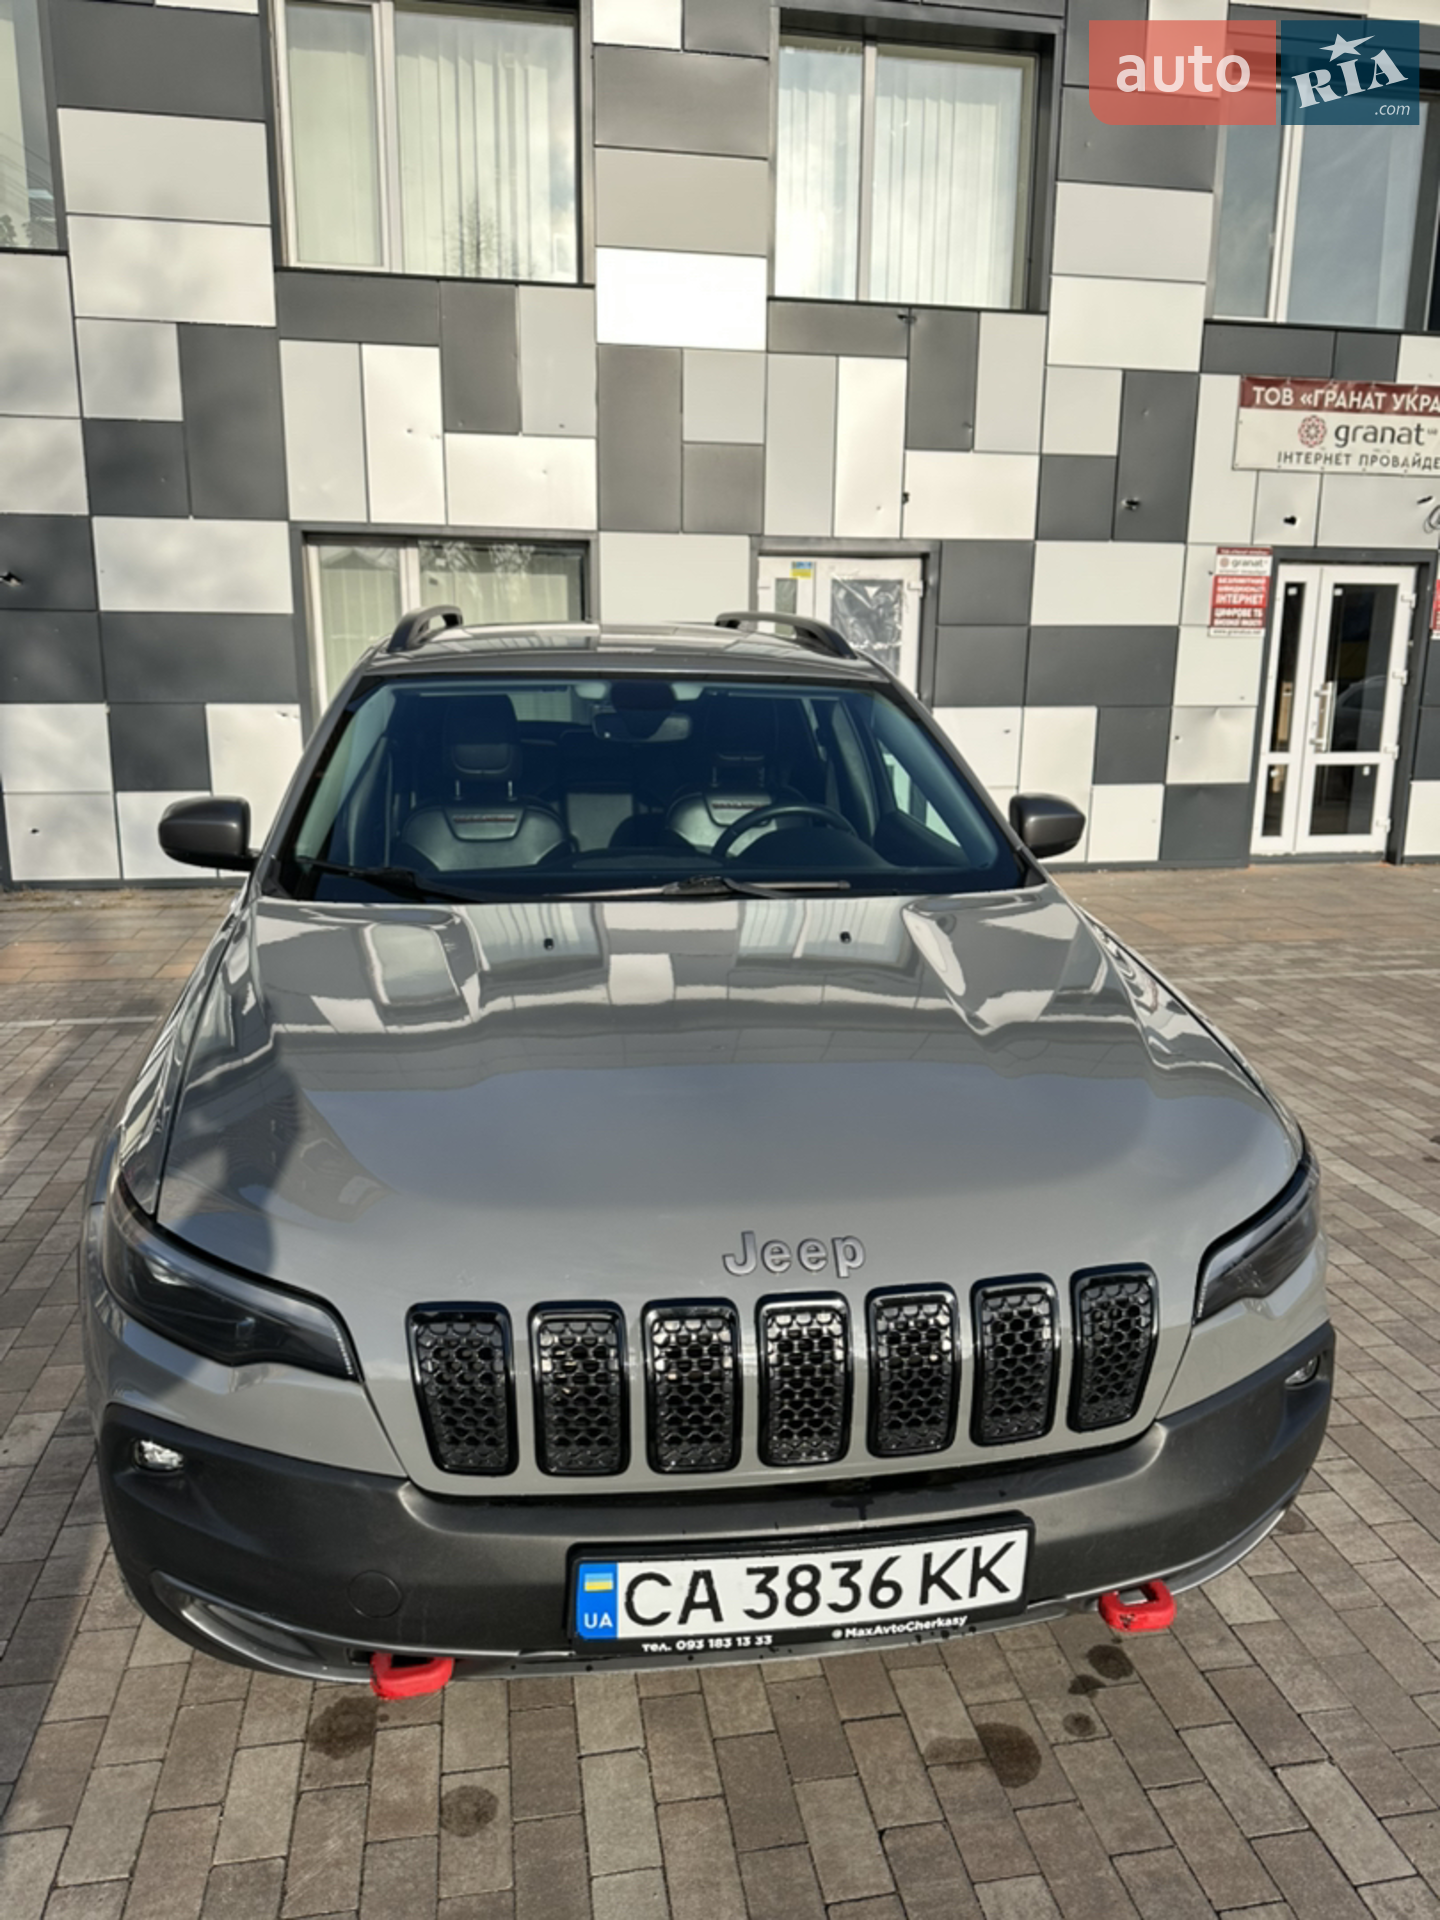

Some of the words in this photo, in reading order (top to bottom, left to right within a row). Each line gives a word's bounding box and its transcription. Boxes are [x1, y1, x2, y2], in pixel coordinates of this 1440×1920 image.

[1252, 386, 1294, 406] ТОВ
[1300, 389, 1387, 411] «ГРАНАТ
[1392, 393, 1440, 413] УКРА
[1334, 423, 1425, 448] granat
[1277, 451, 1352, 466] ІНТЕРНЕТ
[1358, 453, 1440, 471] ПРОВАЙДЕ
[1231, 558, 1264, 568] granat
[722, 1230, 866, 1278] Jeep
[624, 1569, 724, 1626] CA
[743, 1555, 903, 1620] 3836
[918, 1540, 1017, 1606] KK
[584, 1612, 613, 1629] UA
[642, 1642, 672, 1653] тел.
[676, 1639, 704, 1651] 093
[709, 1637, 732, 1649] 183
[736, 1635, 751, 1648] 13
[755, 1634, 773, 1646] 33
